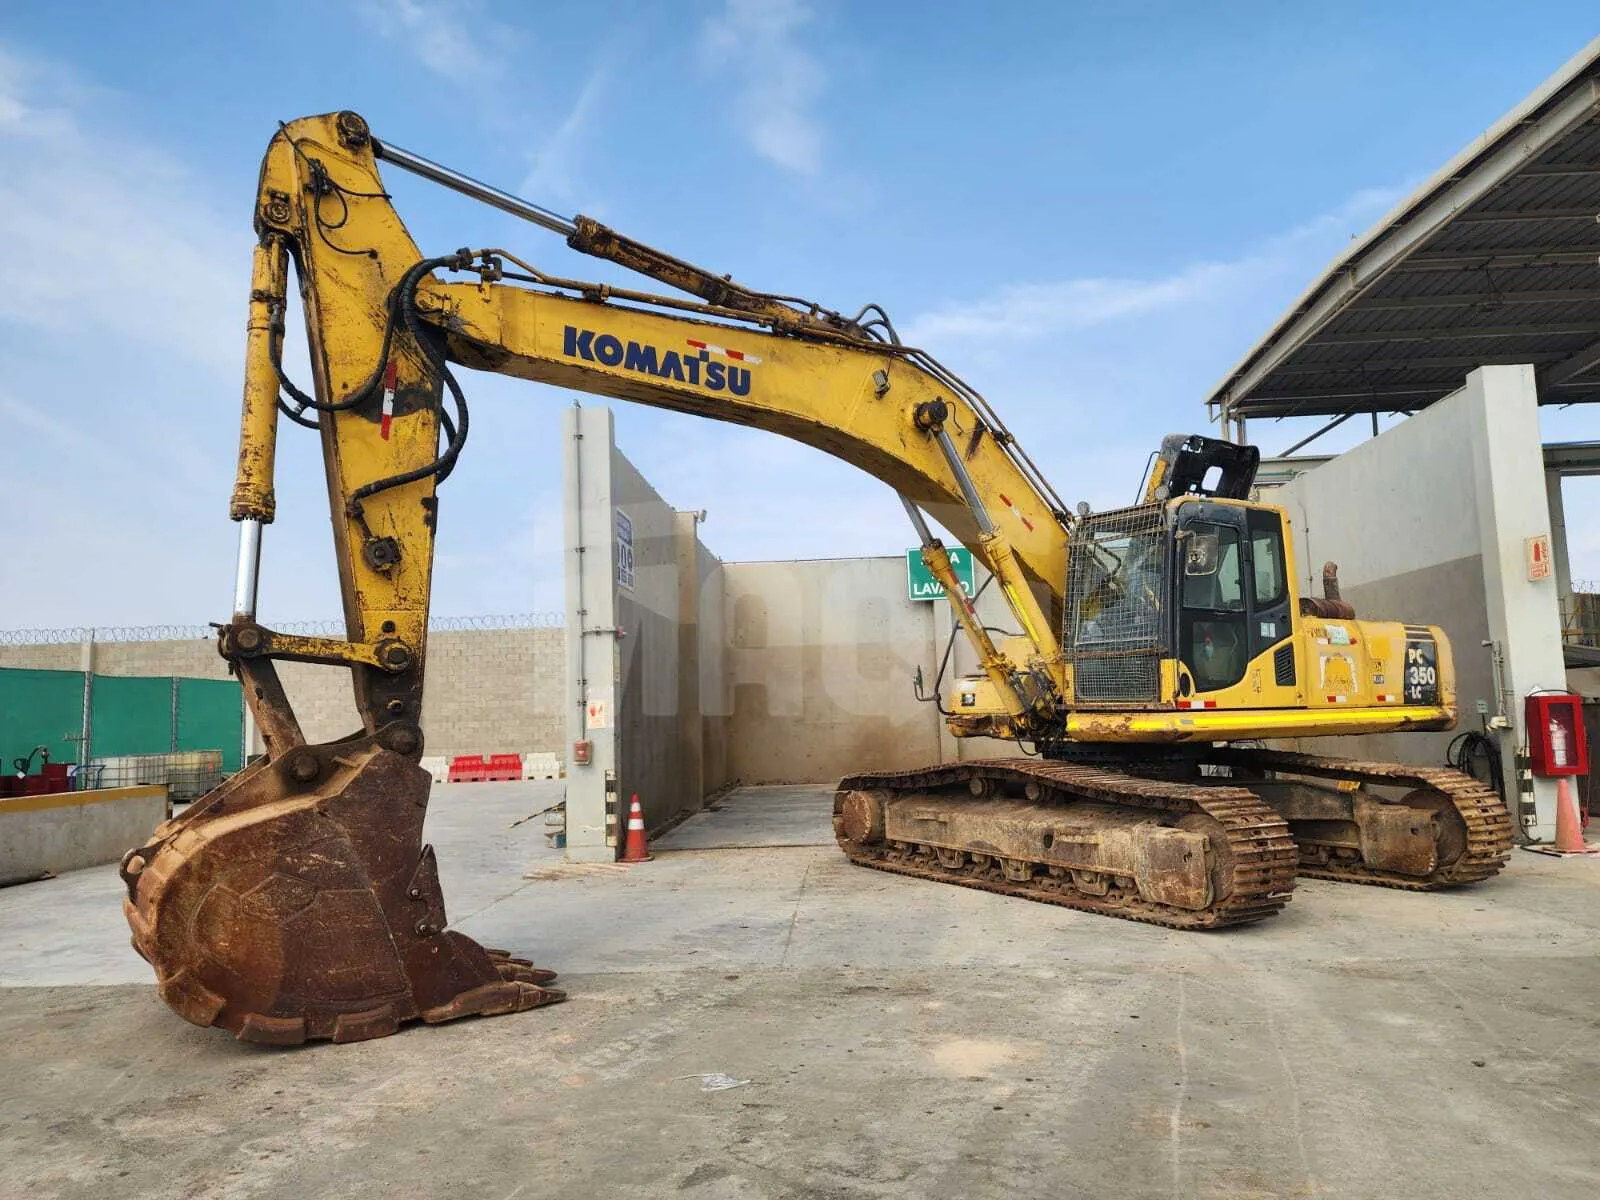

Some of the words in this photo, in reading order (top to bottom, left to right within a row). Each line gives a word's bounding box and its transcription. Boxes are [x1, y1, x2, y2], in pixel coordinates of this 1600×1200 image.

[564, 325, 751, 396] KOMATSU
[1408, 648, 1423, 664] PC
[1410, 666, 1436, 685] 350
[1411, 685, 1422, 699] LC
